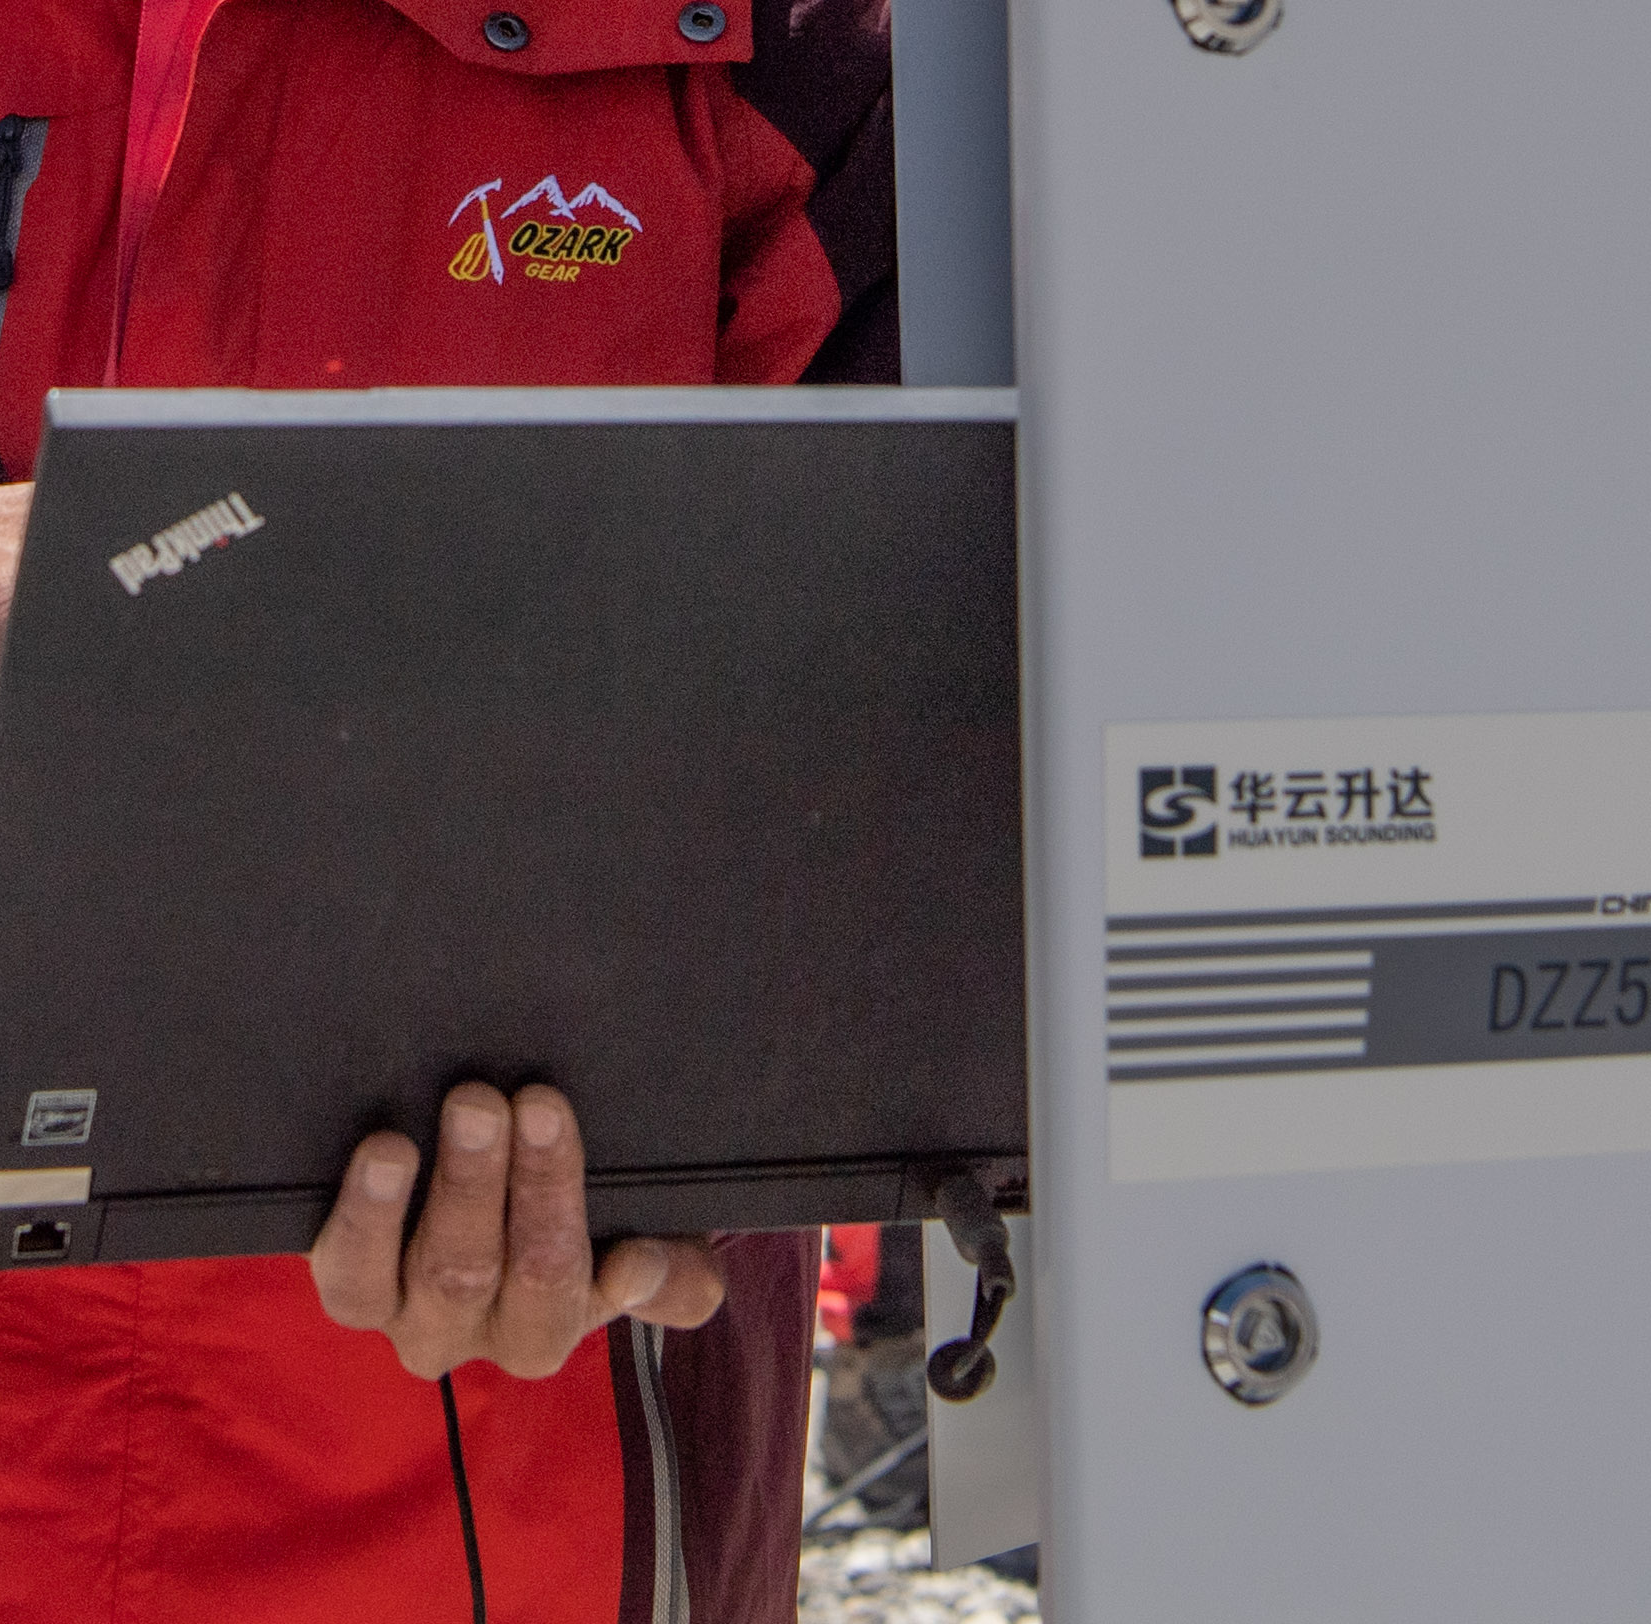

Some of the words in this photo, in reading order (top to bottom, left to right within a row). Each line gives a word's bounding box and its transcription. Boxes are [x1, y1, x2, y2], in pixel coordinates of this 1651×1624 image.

[509, 221, 632, 265] OZARK
[526, 263, 580, 282] GEAR
[108, 491, 267, 596] ThinkPad
[1229, 765, 1434, 823] 华云升达
[1227, 826, 1318, 849] HUAYUN
[1324, 821, 1437, 846] SOUNDING
